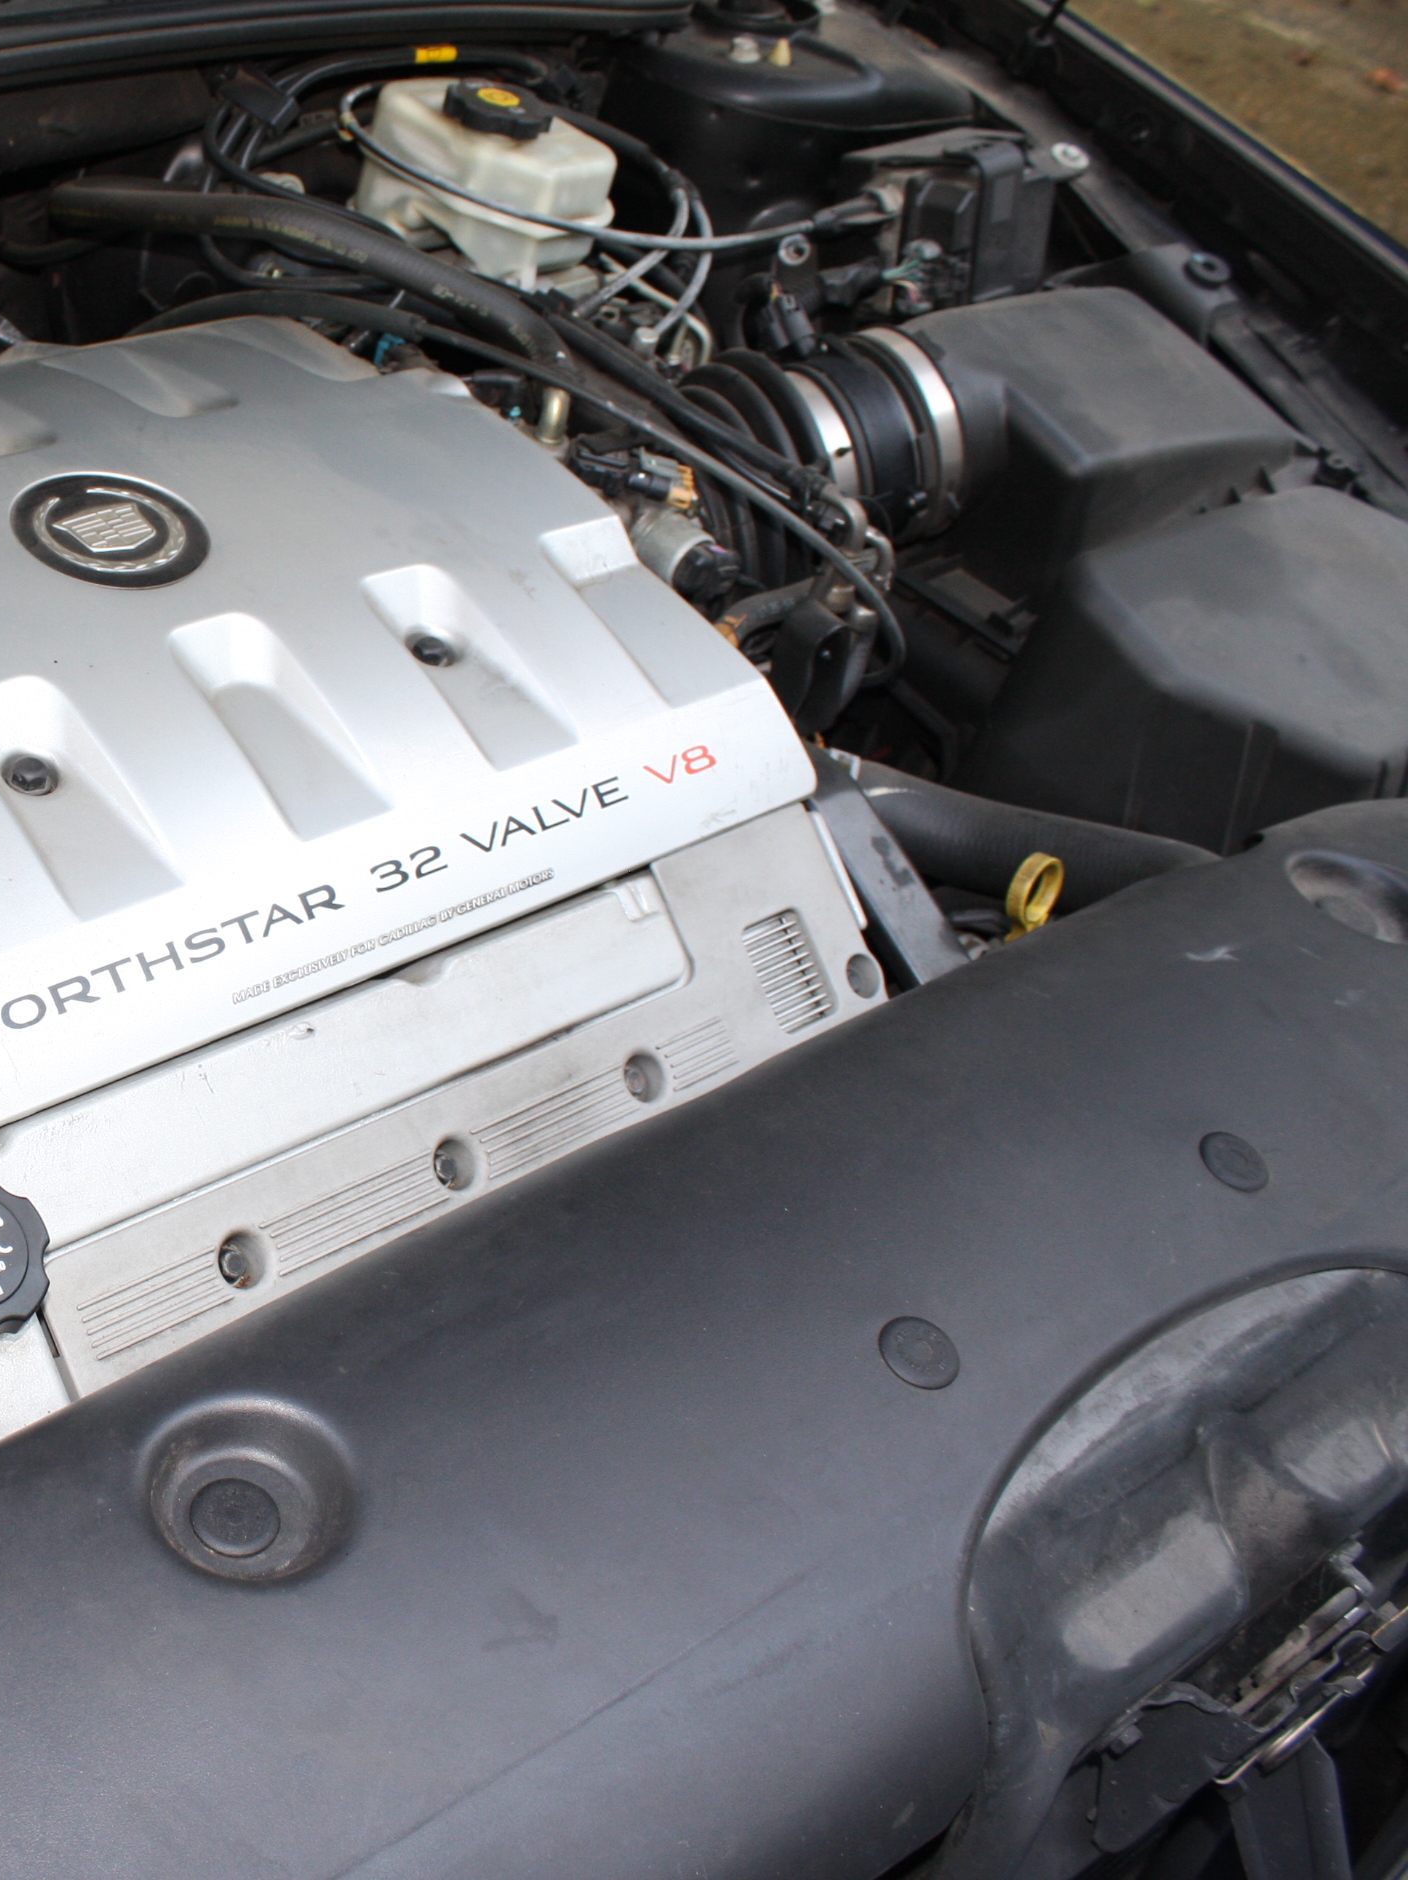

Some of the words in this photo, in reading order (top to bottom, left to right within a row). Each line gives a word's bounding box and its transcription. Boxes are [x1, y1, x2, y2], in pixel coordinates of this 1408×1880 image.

[370, 845, 450, 893] 32
[459, 776, 630, 854] VALVE
[642, 744, 718, 786] V8
[232, 980, 271, 1004] MADE
[273, 949, 349, 989] EXCLUSIVELY
[350, 939, 376, 958] FOR
[378, 915, 437, 946] CADILLAC
[440, 907, 457, 922] BY
[456, 888, 507, 915] GENERAL
[507, 868, 555, 897] MOTORS
